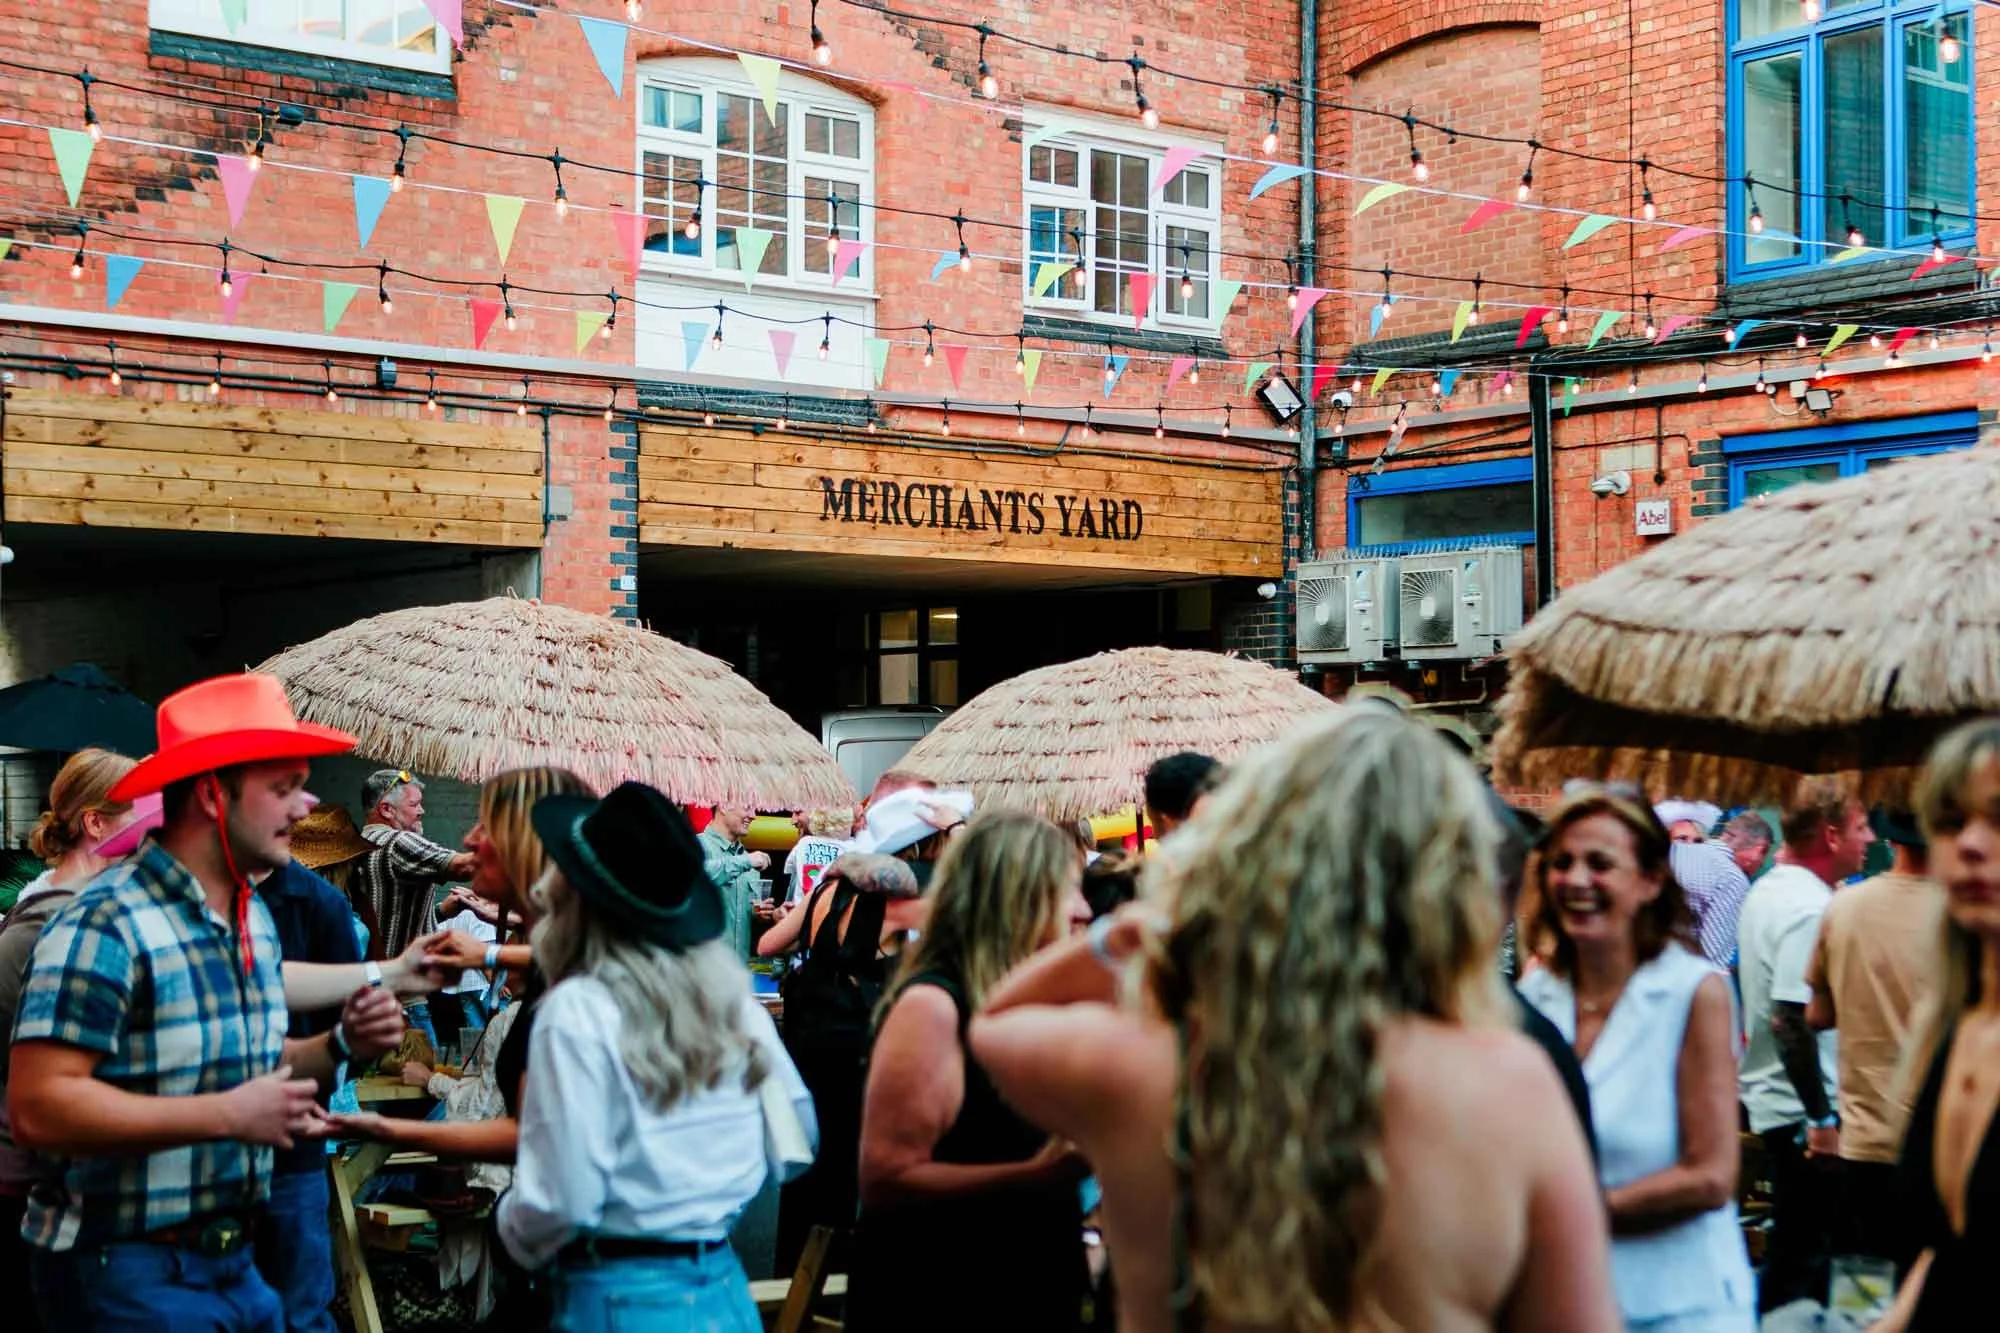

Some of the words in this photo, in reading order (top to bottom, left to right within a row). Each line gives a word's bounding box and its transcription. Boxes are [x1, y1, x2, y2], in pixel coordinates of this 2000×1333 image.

[820, 475, 1045, 535] MERCHANTS
[1054, 494, 1143, 541] YARD
[1640, 508, 1667, 525] Abel
